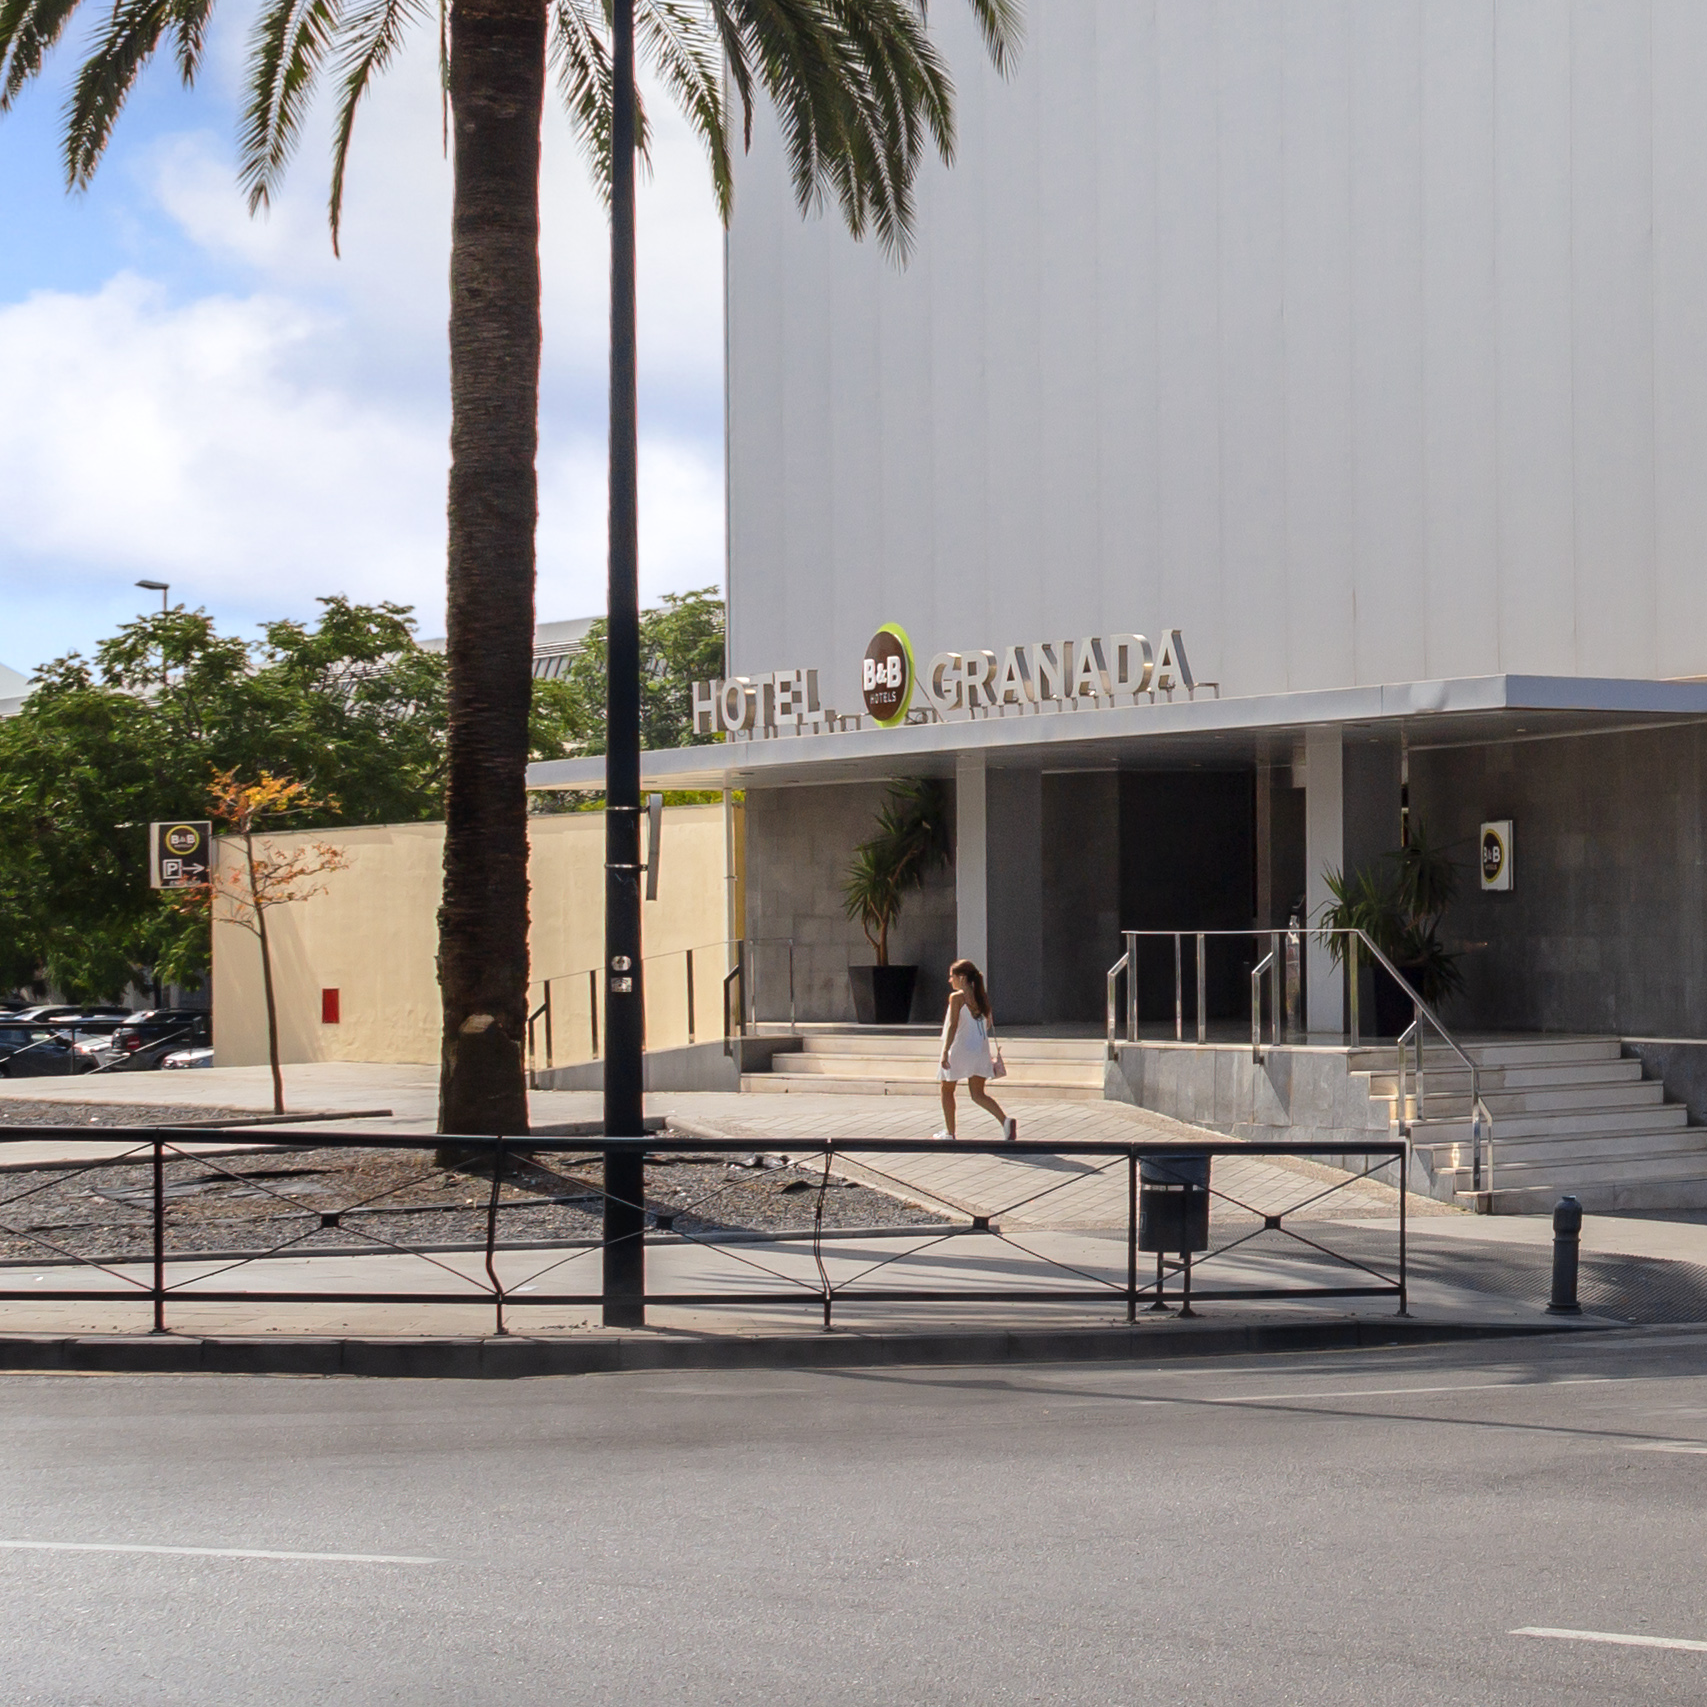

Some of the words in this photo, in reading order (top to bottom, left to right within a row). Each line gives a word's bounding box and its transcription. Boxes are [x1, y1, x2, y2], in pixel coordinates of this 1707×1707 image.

[692, 669, 827, 734] HOTEL
[926, 629, 1196, 711] GRANADA
[863, 655, 902, 691] B&B
[869, 691, 897, 704] HOTELS
[166, 863, 178, 875] P
